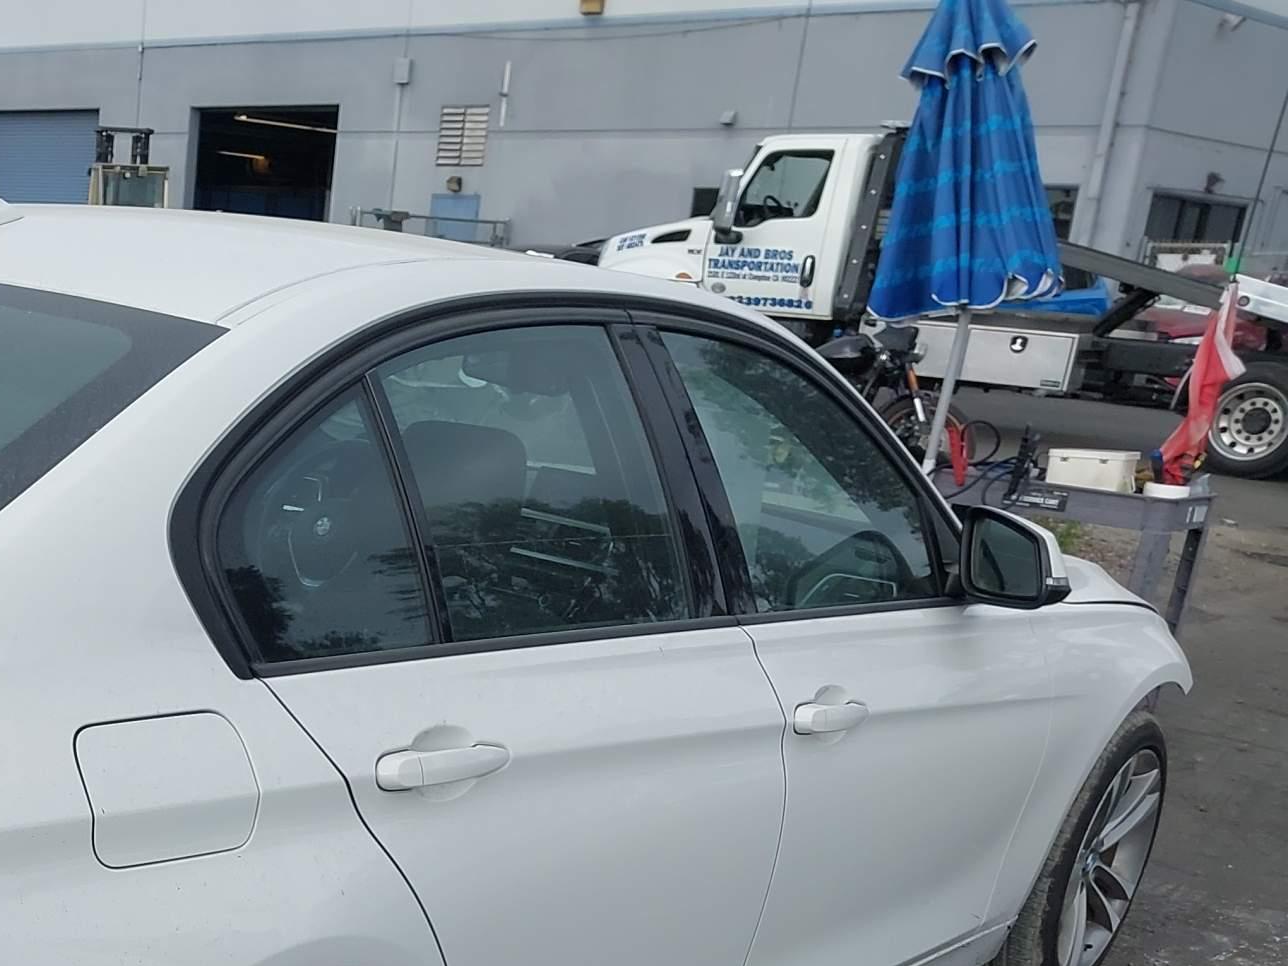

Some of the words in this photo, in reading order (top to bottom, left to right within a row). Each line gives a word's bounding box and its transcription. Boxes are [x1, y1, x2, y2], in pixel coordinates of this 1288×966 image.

[718, 246, 737, 257] JAY
[739, 247, 761, 259] AND
[764, 249, 794, 261] BROS
[708, 258, 799, 274] TRANSPORTATION
